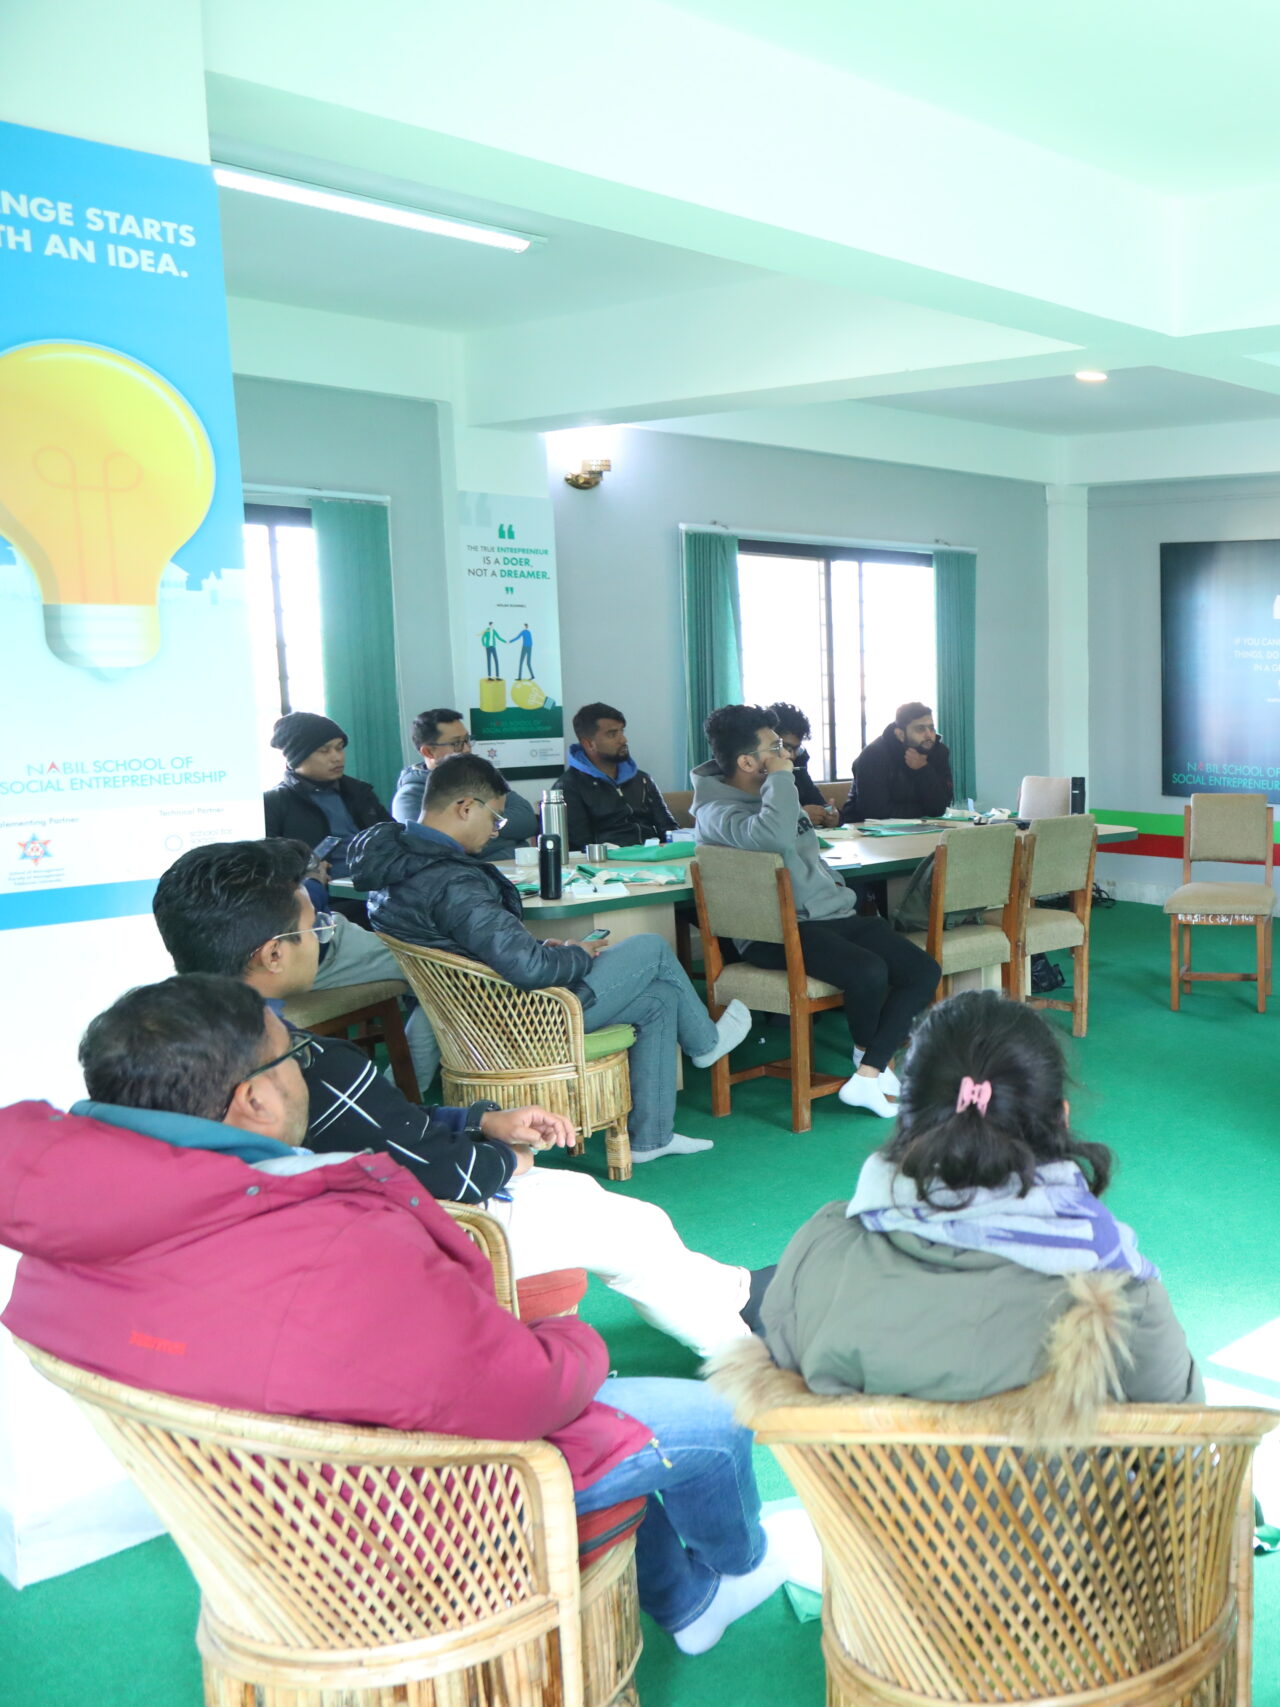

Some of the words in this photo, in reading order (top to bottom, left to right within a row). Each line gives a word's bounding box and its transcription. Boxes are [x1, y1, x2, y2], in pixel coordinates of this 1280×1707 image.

[0, 190, 74, 226] NGE
[86, 207, 196, 247] STARTS
[45, 234, 96, 263] AN
[107, 243, 189, 278] IDEA.
[497, 546, 549, 555] ENTREPRENEUR
[483, 556, 491, 565] IS
[494, 558, 500, 566] A
[468, 568, 488, 577] NOT
[491, 570, 497, 578] A
[500, 569, 550, 580] DREAMER.
[1243, 638, 1260, 647] YOU
[1267, 650, 1279, 660] DO
[27, 760, 89, 776] NABIL
[93, 757, 165, 773] SCHOOL
[171, 756, 193, 770] OF
[1222, 763, 1264, 777] SCHOOL
[0, 779, 64, 795] SOCIAL
[70, 769, 226, 791] ENTREPRENEURSHIP
[1172, 773, 1206, 785] SOCIAL
